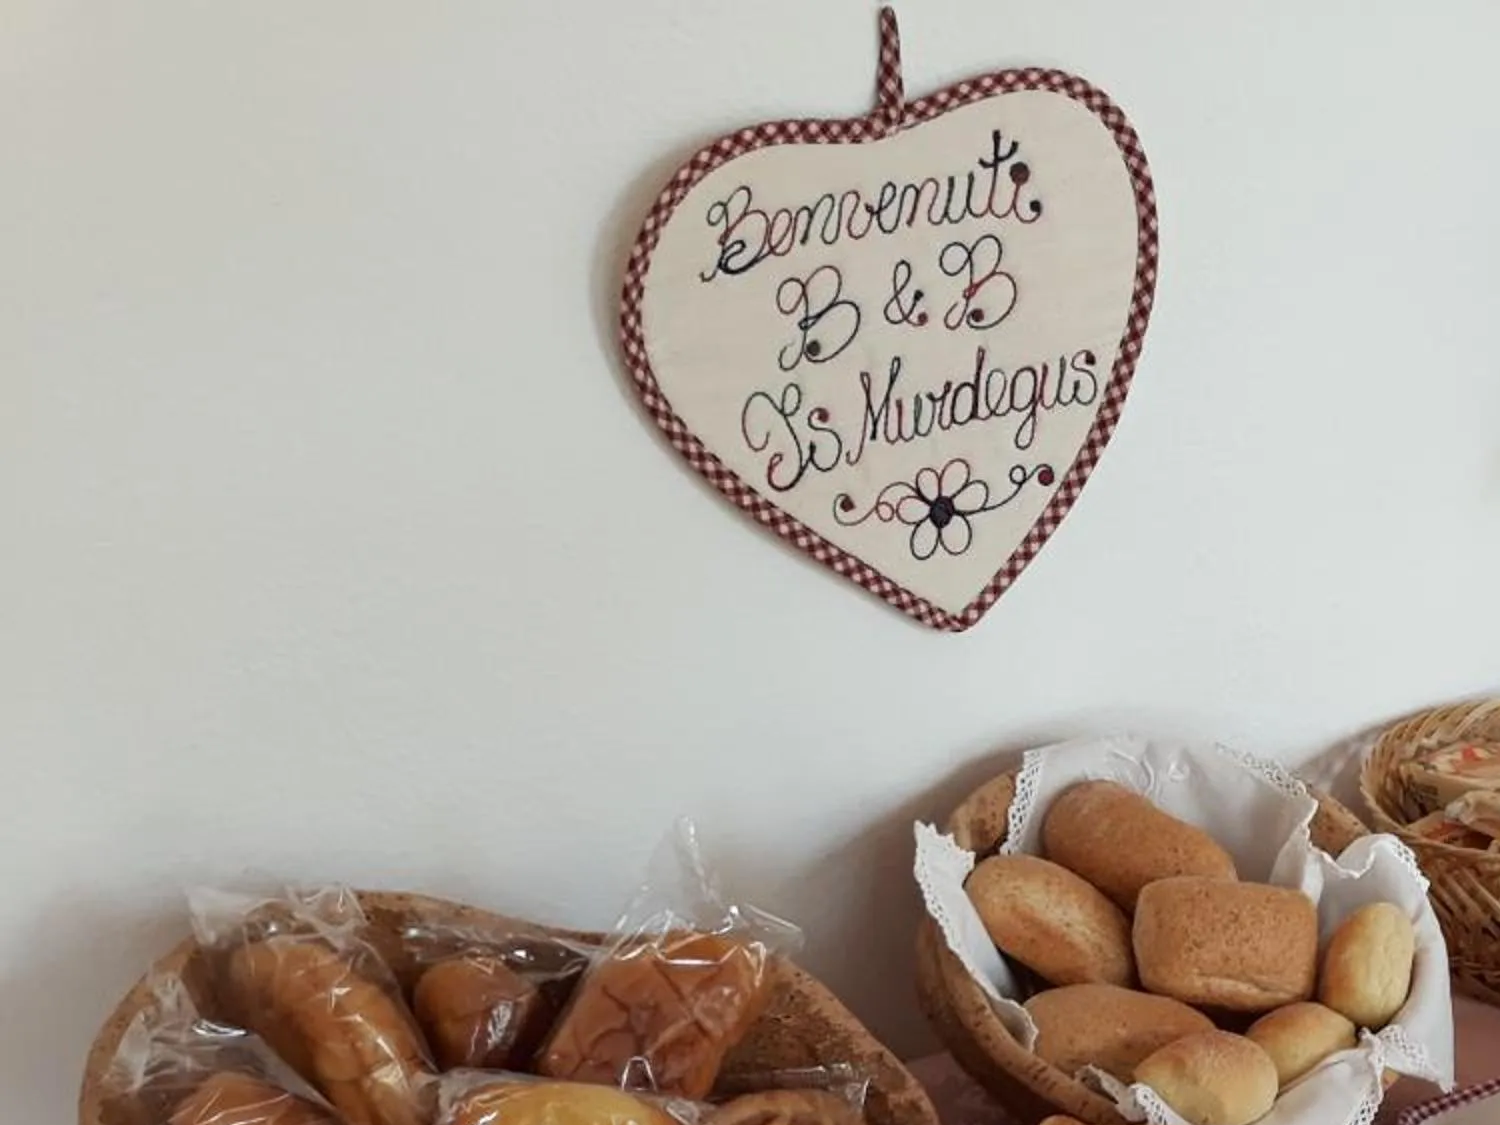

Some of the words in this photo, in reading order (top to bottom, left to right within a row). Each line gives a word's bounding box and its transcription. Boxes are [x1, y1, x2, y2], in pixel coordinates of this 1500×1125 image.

[699, 129, 1043, 282] Benvenuti
[776, 264, 862, 371] B
[884, 260, 930, 326] &
[939, 234, 1018, 330] B
[846, 347, 1098, 467] Murdegus
